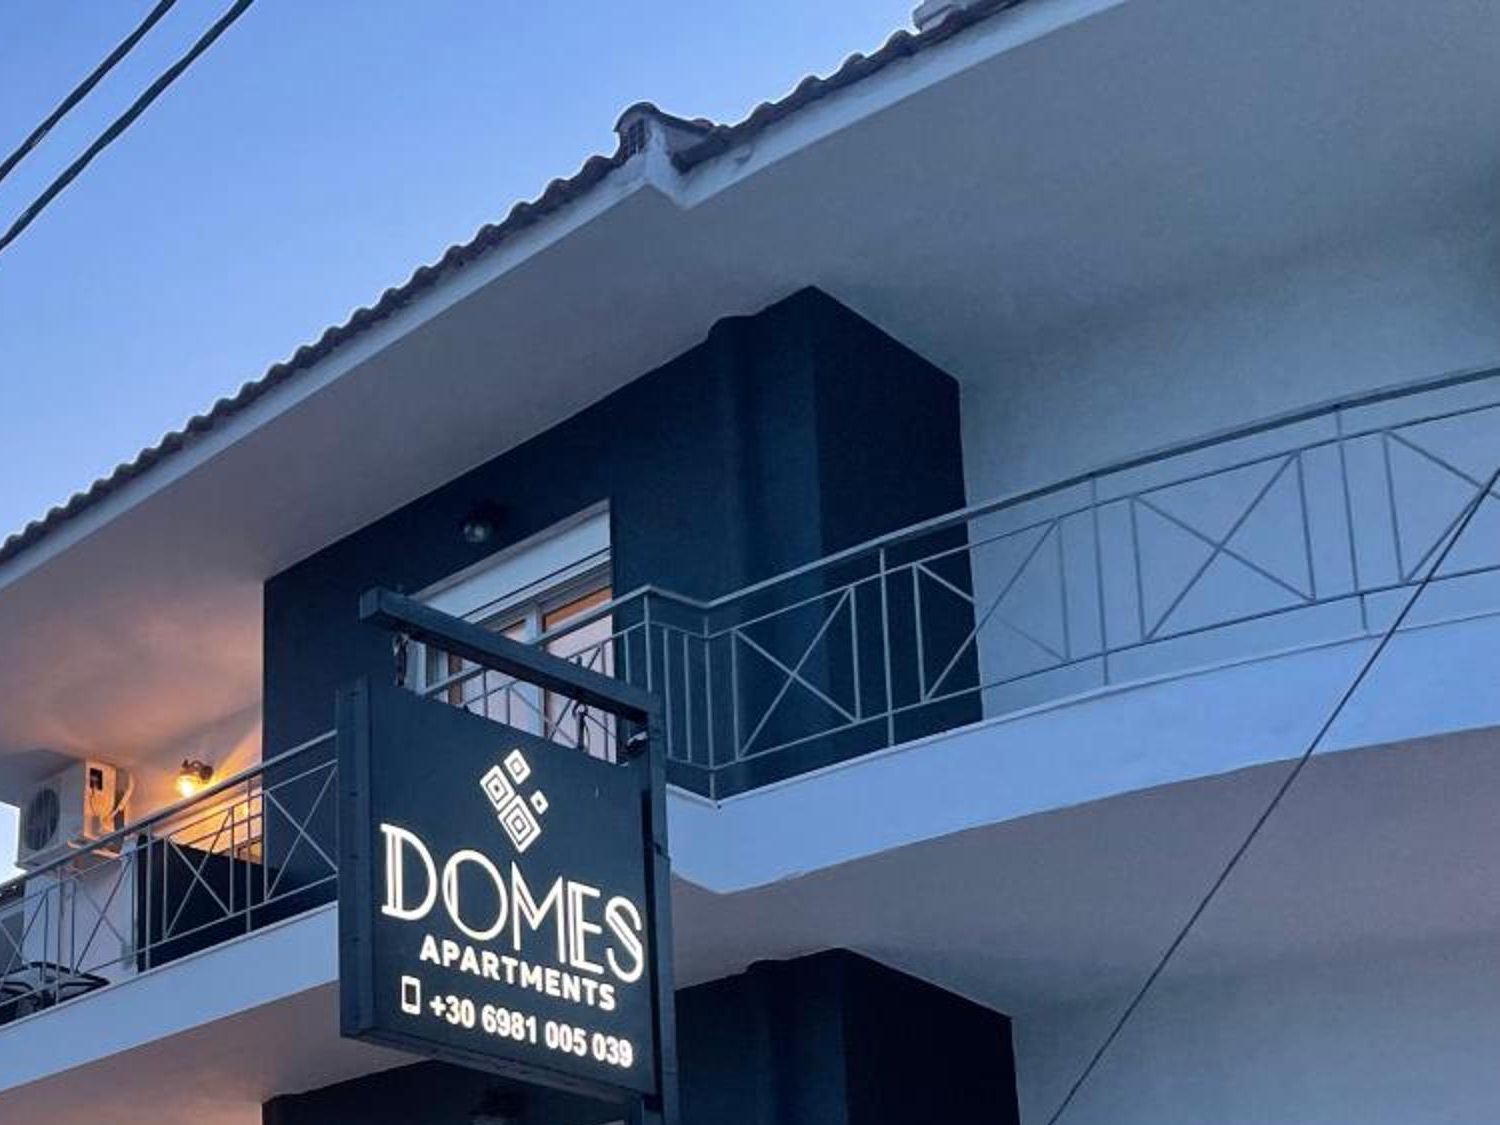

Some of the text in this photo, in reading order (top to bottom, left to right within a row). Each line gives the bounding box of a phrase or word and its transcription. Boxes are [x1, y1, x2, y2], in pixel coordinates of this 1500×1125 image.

[380, 823, 645, 983] DOMES
[419, 934, 616, 1011] APARTMENTS
[429, 995, 634, 1068] +30 6981 005 039
